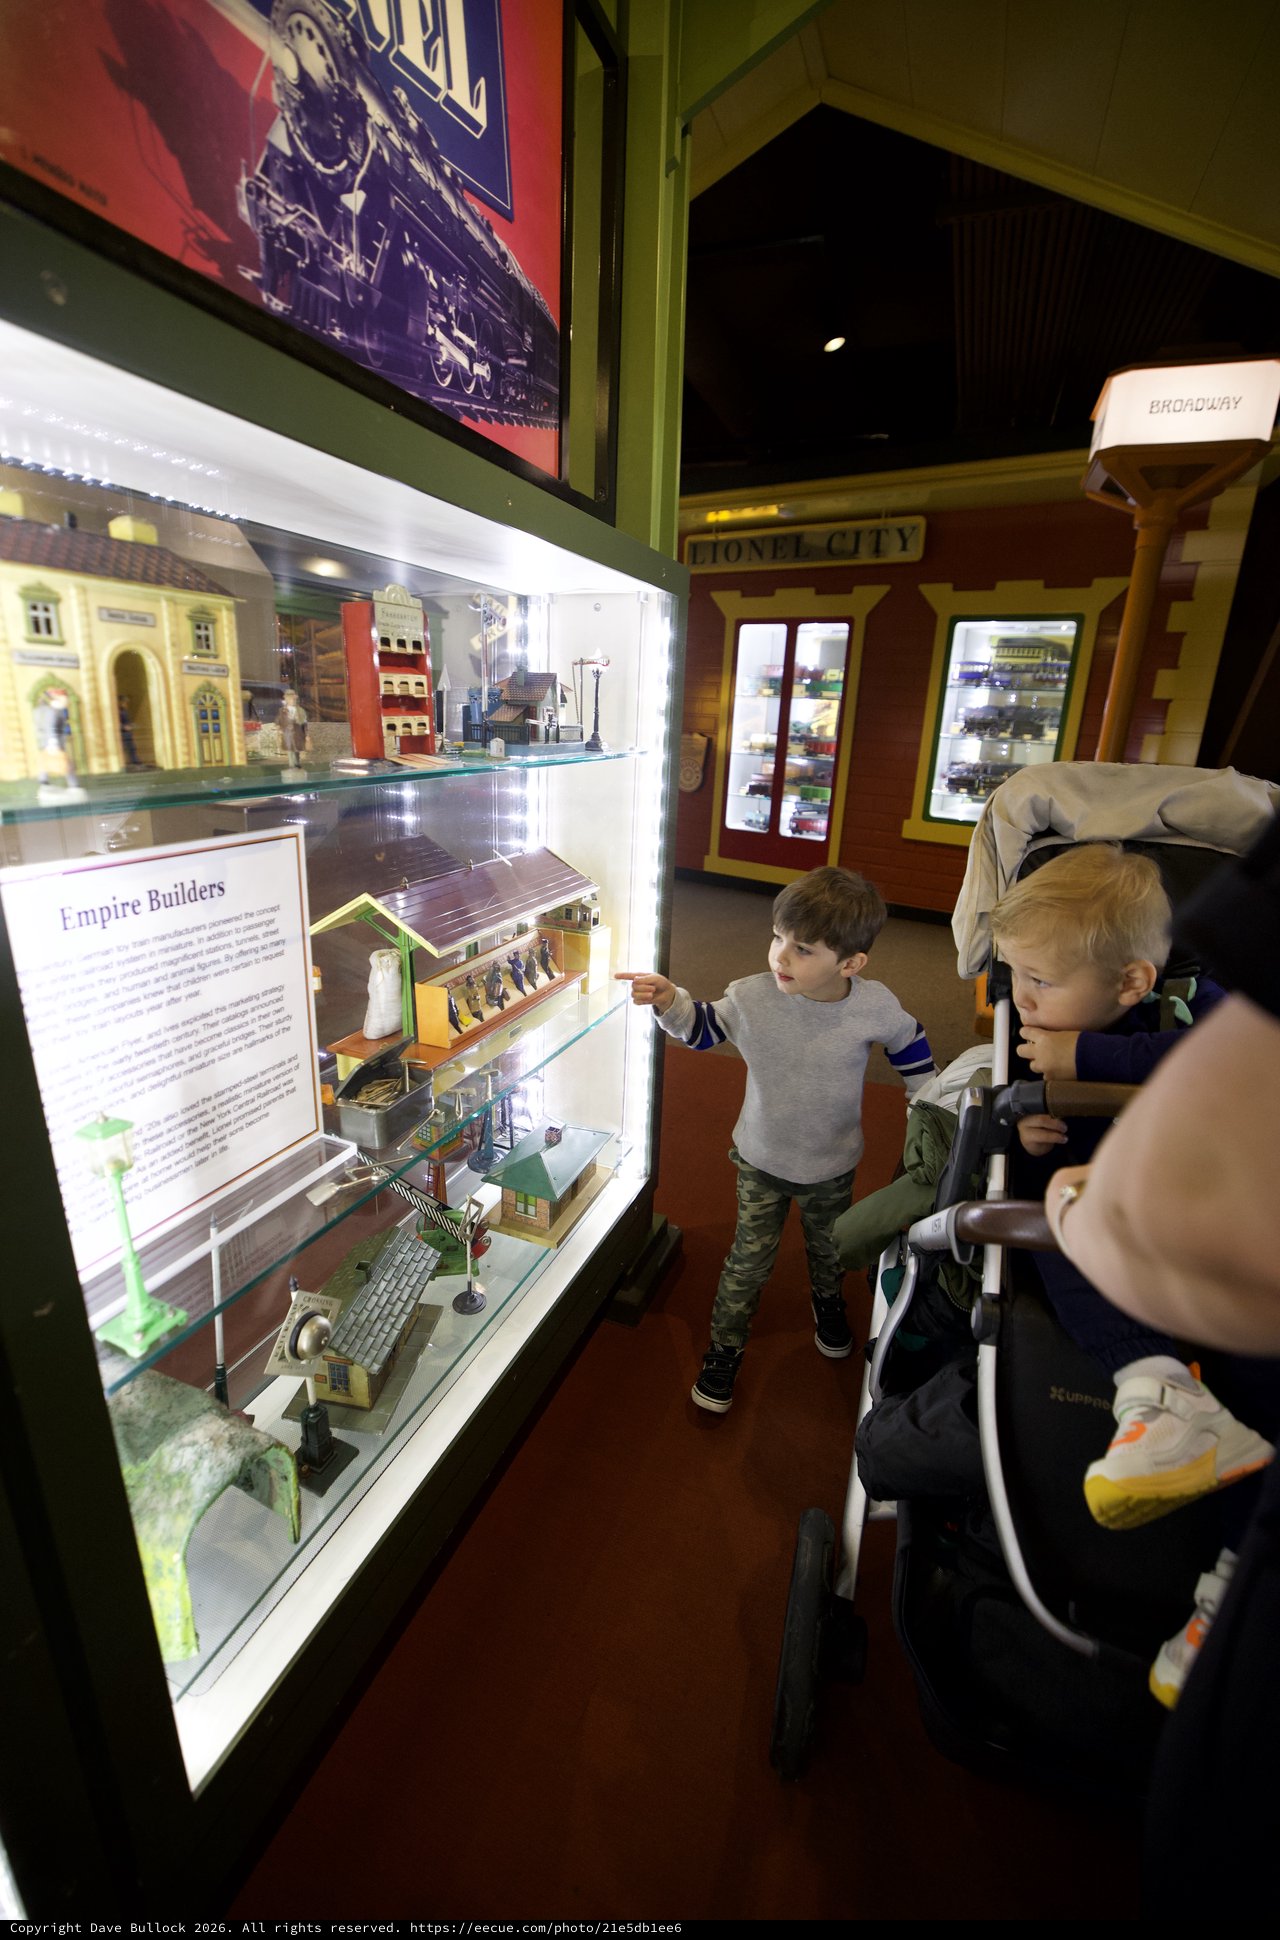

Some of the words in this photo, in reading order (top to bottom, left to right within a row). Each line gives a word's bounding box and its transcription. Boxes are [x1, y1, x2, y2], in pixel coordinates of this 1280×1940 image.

[1149, 396, 1243, 414] BROADWAY
[690, 533, 812, 566] LIONEL
[826, 526, 918, 558] CITY
[60, 896, 141, 931] Empire
[147, 880, 226, 912] Builders
[131, 935, 149, 948] train
[152, 921, 206, 943] manufacturers
[208, 911, 242, 930] pioneered
[244, 909, 254, 919] the
[255, 902, 280, 918] concept
[103, 986, 119, 999] and
[121, 976, 150, 993] human
[153, 971, 167, 983] and
[170, 963, 194, 978] animal
[224, 951, 233, 963] By
[234, 944, 258, 960] offering
[269, 937, 286, 949] many
[116, 950, 146, 969] system
[148, 948, 155, 957] in
[197, 934, 203, 944] In
[206, 926, 232, 941] addition
[234, 925, 241, 934] to
[242, 917, 275, 934] passenger
[118, 961, 158, 982] produced
[160, 947, 203, 970] magnificent
[262, 926, 279, 938] street
[143, 986, 163, 1000] knew
[166, 980, 180, 992] that
[183, 971, 210, 987] children
[213, 966, 229, 977] were
[231, 957, 252, 971] certain
[254, 955, 260, 964] to
[261, 947, 284, 963] request
[113, 1006, 143, 1026] layouts
[146, 1001, 162, 1015] year
[165, 993, 181, 1006] after
[134, 1036, 169, 1057] twentieth
[202, 1017, 219, 1030] Their
[221, 1006, 248, 1025] catalogs
[250, 993, 283, 1012] announced
[146, 1027, 161, 1039] and
[163, 1020, 179, 1033] Ives
[180, 1008, 213, 1028] exploited
[214, 1003, 226, 1014] this
[228, 990, 259, 1010] marketing
[261, 982, 284, 999] strategy
[187, 1049, 201, 1062] and
[203, 1037, 230, 1057] graceful
[259, 1020, 273, 1032] Their
[275, 1012, 292, 1027] sturdy
[107, 1055, 155, 1082] accessories
[158, 1048, 172, 1061] that
[174, 1040, 192, 1055] have
[194, 1028, 222, 1046] become
[223, 1018, 248, 1034] classics
[250, 1015, 256, 1024] in
[257, 1009, 270, 1021] their
[272, 1005, 284, 1015] own
[129, 1086, 145, 1099] and
[147, 1070, 181, 1093] delightful
[183, 1055, 215, 1076] miniature
[217, 1049, 230, 1061] size
[232, 1045, 242, 1054] are
[244, 1031, 273, 1050] hallmarks
[274, 1028, 280, 1036] of
[281, 1023, 290, 1033] the
[142, 1128, 163, 1146] these
[217, 1090, 241, 1108] realistic
[243, 1075, 271, 1095] miniature
[272, 1065, 292, 1081] version
[293, 1062, 299, 1071] of
[163, 1109, 178, 1122] also
[180, 1099, 199, 1114] loved
[200, 1092, 211, 1104] the
[213, 1070, 258, 1100] stamped-steel
[259, 1058, 285, 1076] terminals
[287, 1052, 297, 1063] and
[136, 1162, 146, 1174] As
[148, 1158, 157, 1167] an
[160, 1143, 183, 1161] added
[212, 1118, 231, 1134] Lionel
[233, 1102, 261, 1124] promised
[262, 1090, 284, 1109] parents
[285, 1084, 296, 1095] that
[144, 1135, 175, 1157] Railroad
[178, 1132, 184, 1140] or
[186, 1123, 197, 1135] the
[199, 1115, 215, 1129] New
[217, 1107, 230, 1120] York
[232, 1094, 255, 1112] Central
[256, 1082, 280, 1100] Railroad
[282, 1076, 293, 1087] was
[141, 1174, 148, 1184] at
[150, 1161, 172, 1179] home
[174, 1149, 195, 1166] would
[196, 1140, 211, 1156] help
[212, 1132, 226, 1145] their
[229, 1124, 243, 1136] sons
[245, 1109, 269, 1128] become
[144, 1162, 192, 1195] businessmen
[194, 1153, 208, 1167] later
[210, 1148, 216, 1157] in
